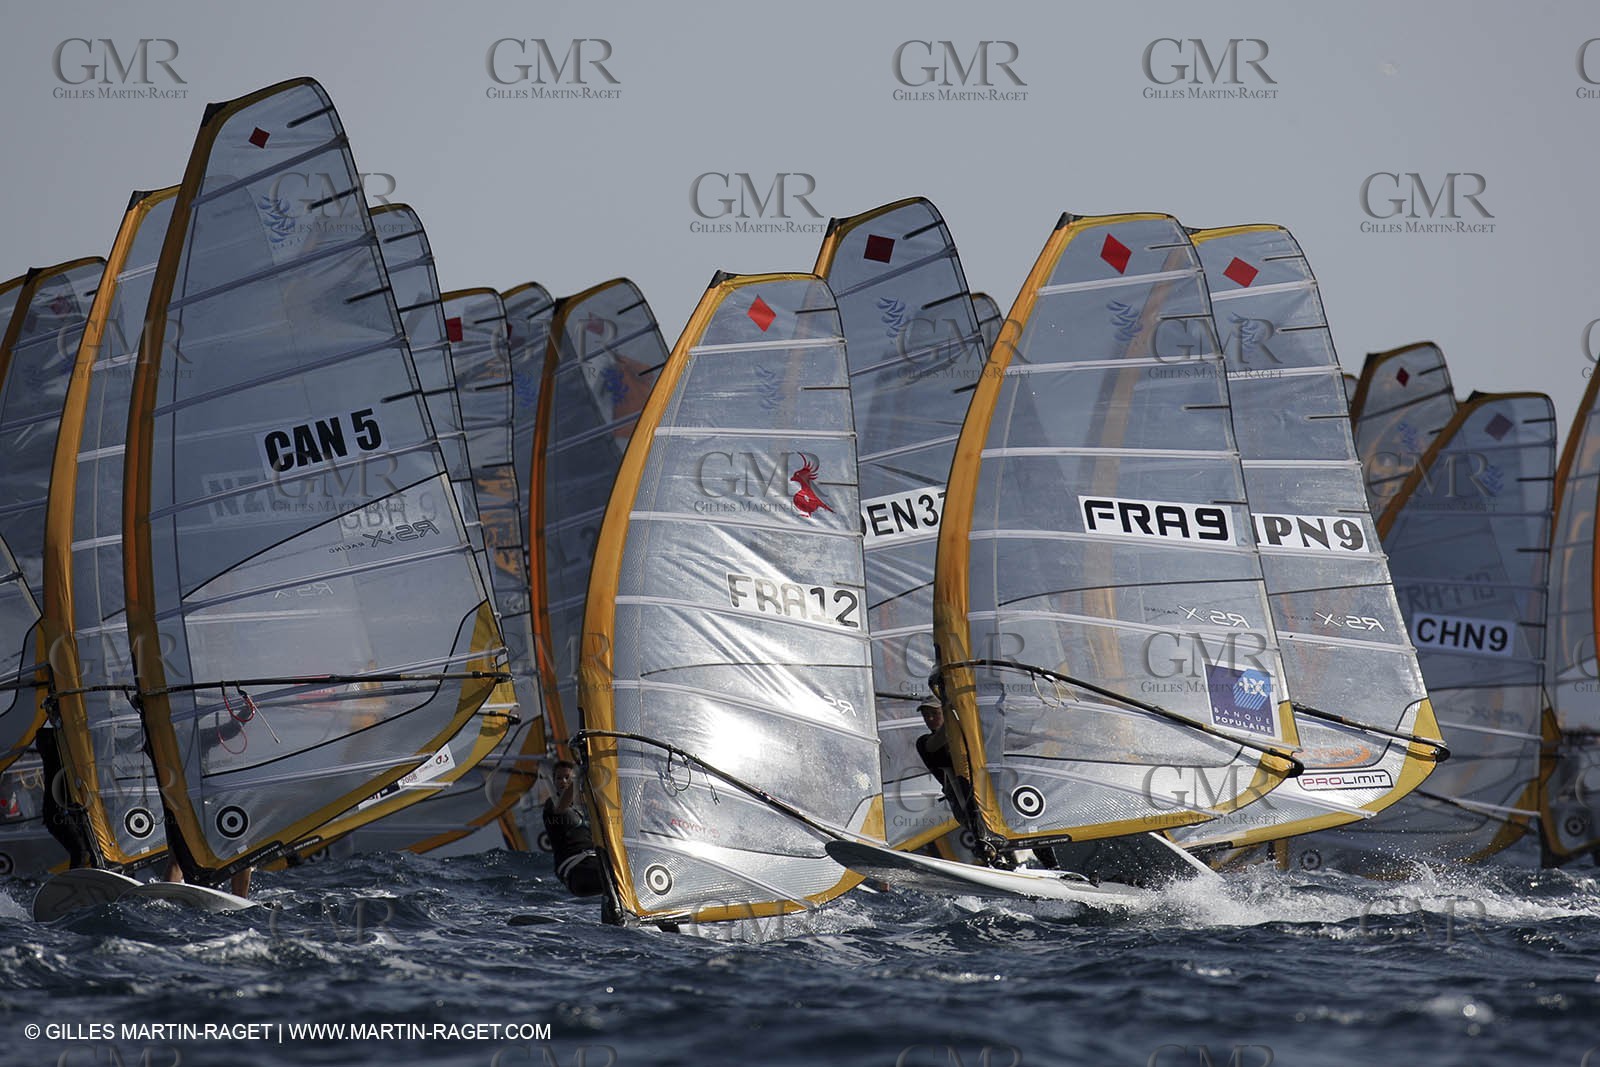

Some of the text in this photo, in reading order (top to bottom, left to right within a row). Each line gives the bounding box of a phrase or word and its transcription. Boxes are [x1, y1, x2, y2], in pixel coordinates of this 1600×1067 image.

[264, 408, 382, 473] CAN 5
[1083, 499, 1230, 542] FRA9
[727, 573, 859, 628] FRA12
[1416, 617, 1509, 653] CHN9
[1214, 706, 1271, 725] BANQUE
[1214, 714, 1273, 735] POPULAIRE
[1302, 774, 1387, 788] PROLIMIT
